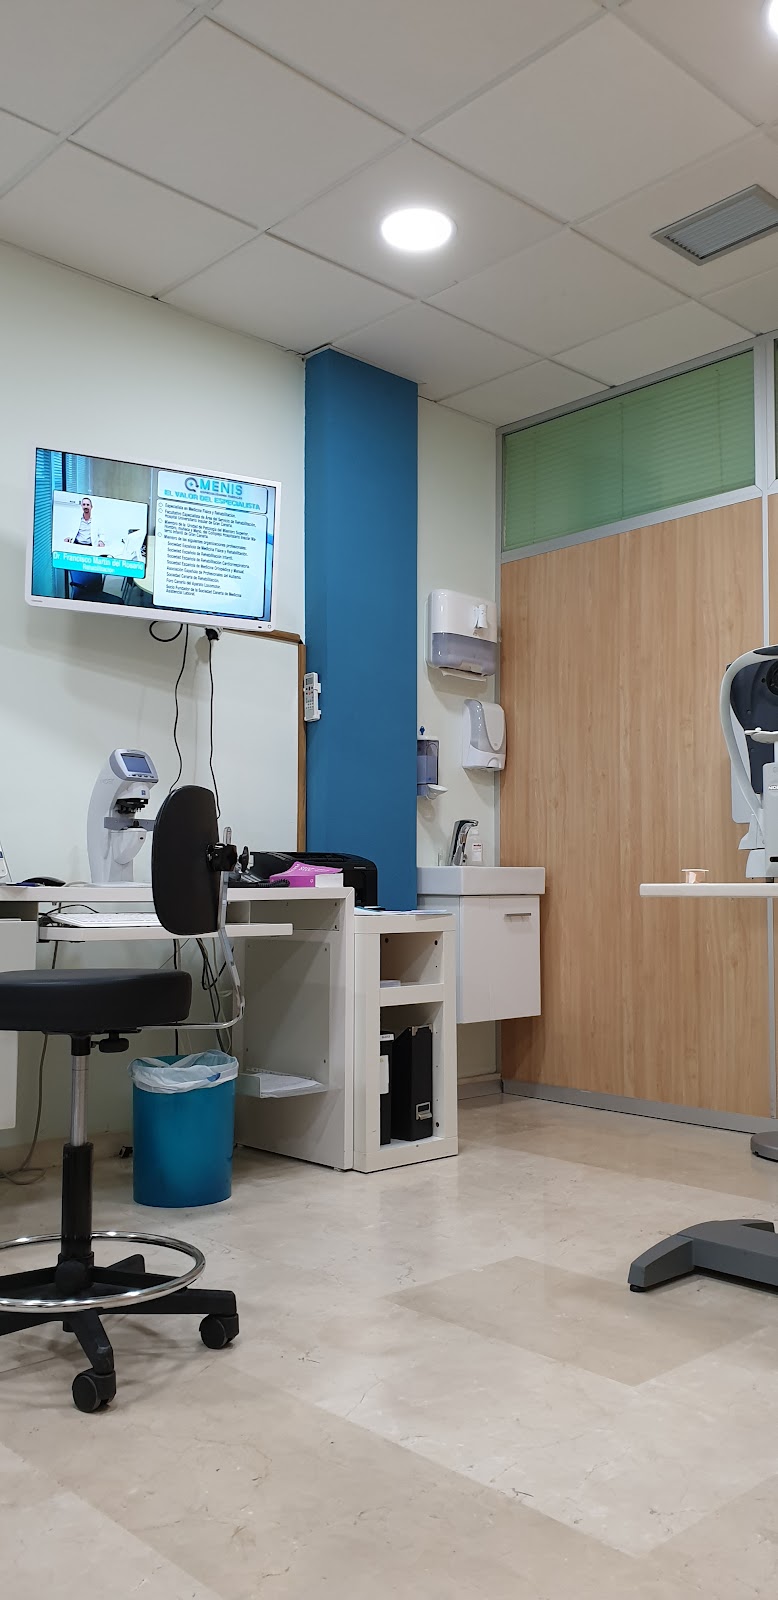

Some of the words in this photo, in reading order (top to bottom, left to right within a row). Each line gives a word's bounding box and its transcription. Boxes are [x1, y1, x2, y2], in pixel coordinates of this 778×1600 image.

[175, 491, 198, 501] VALOR
[214, 497, 261, 510] ESPECIALISTA
[63, 553, 92, 563] Francisco
[112, 558, 120, 566] del
[122, 559, 143, 569] Rosario
